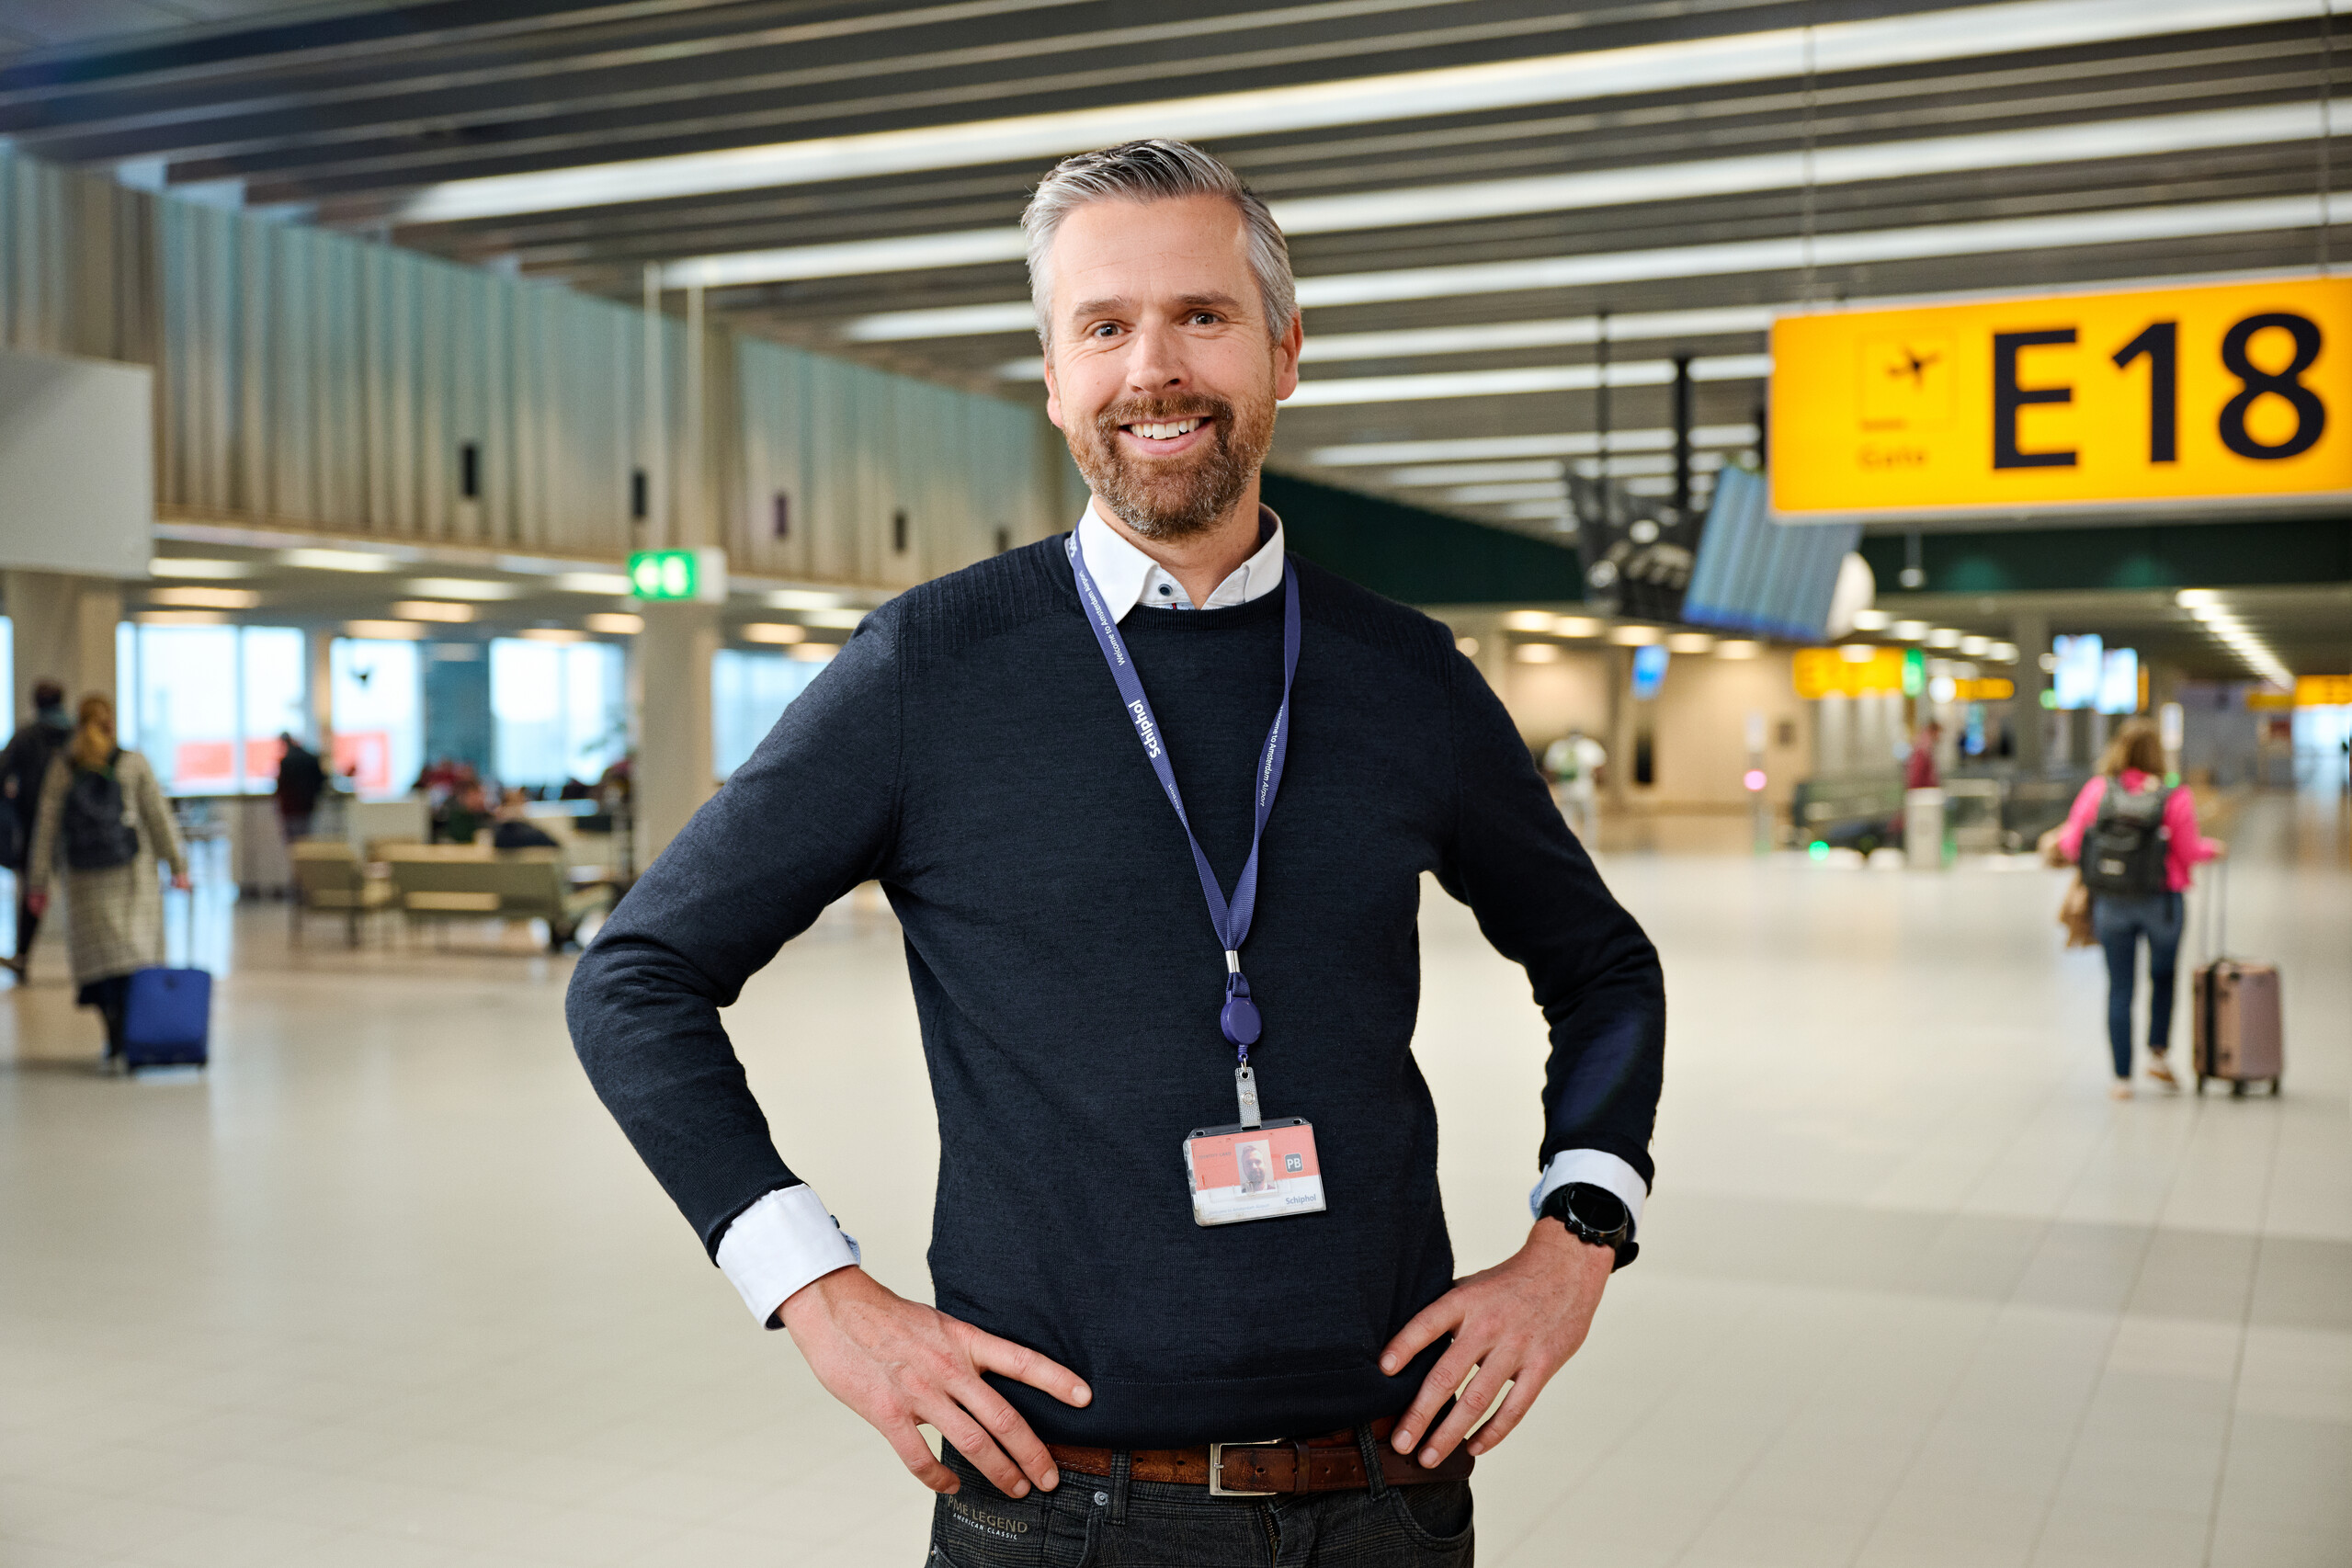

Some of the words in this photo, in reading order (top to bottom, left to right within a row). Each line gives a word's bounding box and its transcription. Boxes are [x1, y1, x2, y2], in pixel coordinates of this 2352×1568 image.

[1992, 310, 2328, 472] E18
[1088, 590, 1108, 626] Amsterdam
[1105, 626, 1112, 634] to
[1108, 634, 1126, 665] Welcome
[1128, 699, 1161, 758] Schiphol
[1270, 734, 1278, 743] to
[1263, 743, 1277, 781] Amsterdam
[1260, 781, 1269, 807] Airport
[1287, 1157, 1301, 1169] PB
[1285, 1193, 1317, 1205] Schiphol
[948, 1494, 969, 1517] PME
[972, 1508, 1028, 1534] LEGEND
[953, 1512, 984, 1530] AMERICAN
[987, 1528, 1018, 1540] CLASSIC
